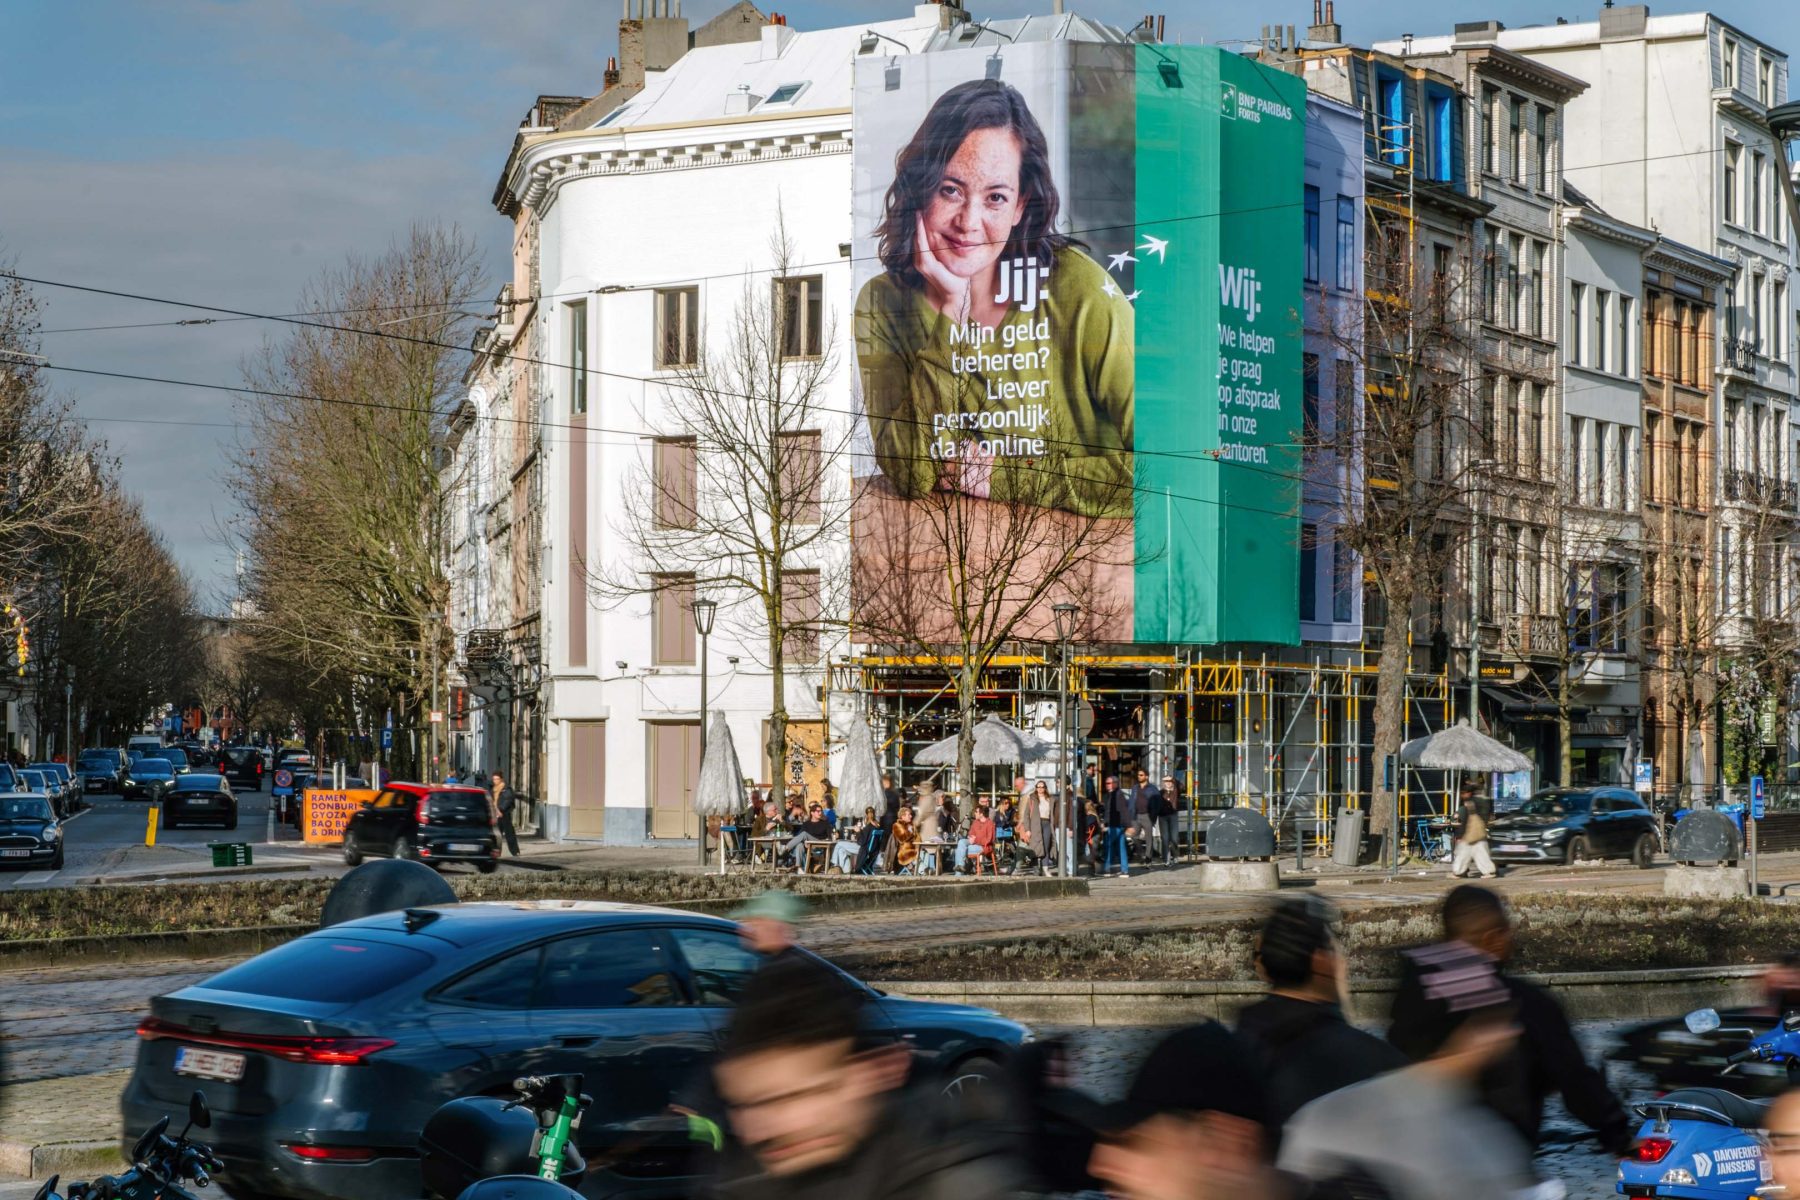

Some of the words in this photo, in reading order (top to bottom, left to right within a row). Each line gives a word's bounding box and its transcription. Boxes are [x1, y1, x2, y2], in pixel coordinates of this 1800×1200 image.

[1238, 92, 1256, 109] BNP
[1257, 98, 1292, 120] PARIBAS
[1238, 107, 1261, 123] FORTIS
[994, 257, 1050, 312] Jij:
[1218, 264, 1261, 322] Wij:
[949, 322, 995, 350] Mijn
[1002, 317, 1051, 348] geld
[1217, 322, 1236, 348] We
[1240, 327, 1275, 357] helpen
[951, 347, 1051, 374] beheren?
[1215, 352, 1228, 379] je
[1231, 359, 1262, 385] graag
[986, 378, 1050, 400] Liever
[1218, 385, 1232, 408] op
[1235, 383, 1281, 412] afspraak
[933, 403, 1051, 436] persoonlijk
[1217, 408, 1229, 431] in
[1231, 415, 1257, 435] onze
[978, 434, 1048, 457] online.
[1218, 436, 1269, 464] kantoren.
[383, 731, 392, 746] P
[1636, 764, 1645, 777] P
[311, 794, 347, 802] RAMEN
[311, 811, 347, 819] GYOZA
[335, 820, 349, 828] BU
[1713, 1145, 1762, 1162] DAKWERKEN
[542, 1156, 559, 1181] olt
[1717, 1159, 1756, 1176] JANSSENS
